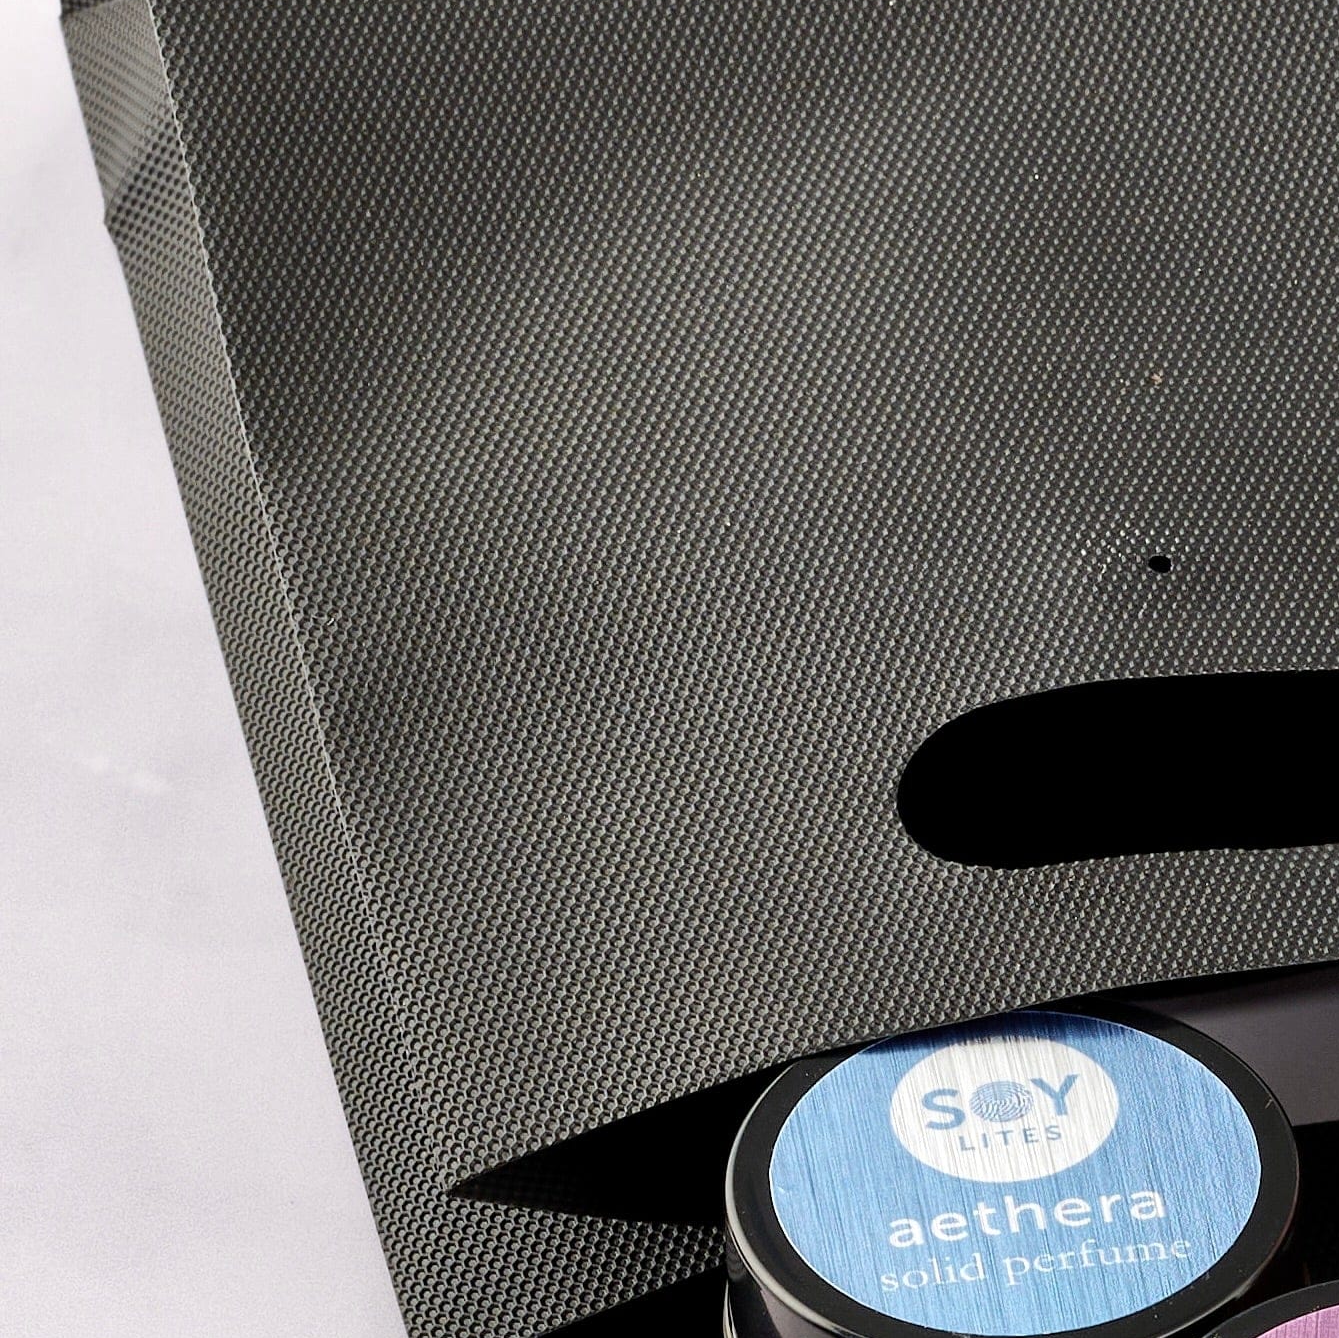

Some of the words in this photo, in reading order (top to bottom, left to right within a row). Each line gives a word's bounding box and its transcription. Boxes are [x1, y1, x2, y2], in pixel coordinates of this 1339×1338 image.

[922, 1073, 1079, 1131] SOY
[958, 1124, 1063, 1153] LITES
[888, 1189, 1168, 1249] aethera
[879, 1251, 986, 1293] solid
[1002, 1235, 1193, 1287] perfume
